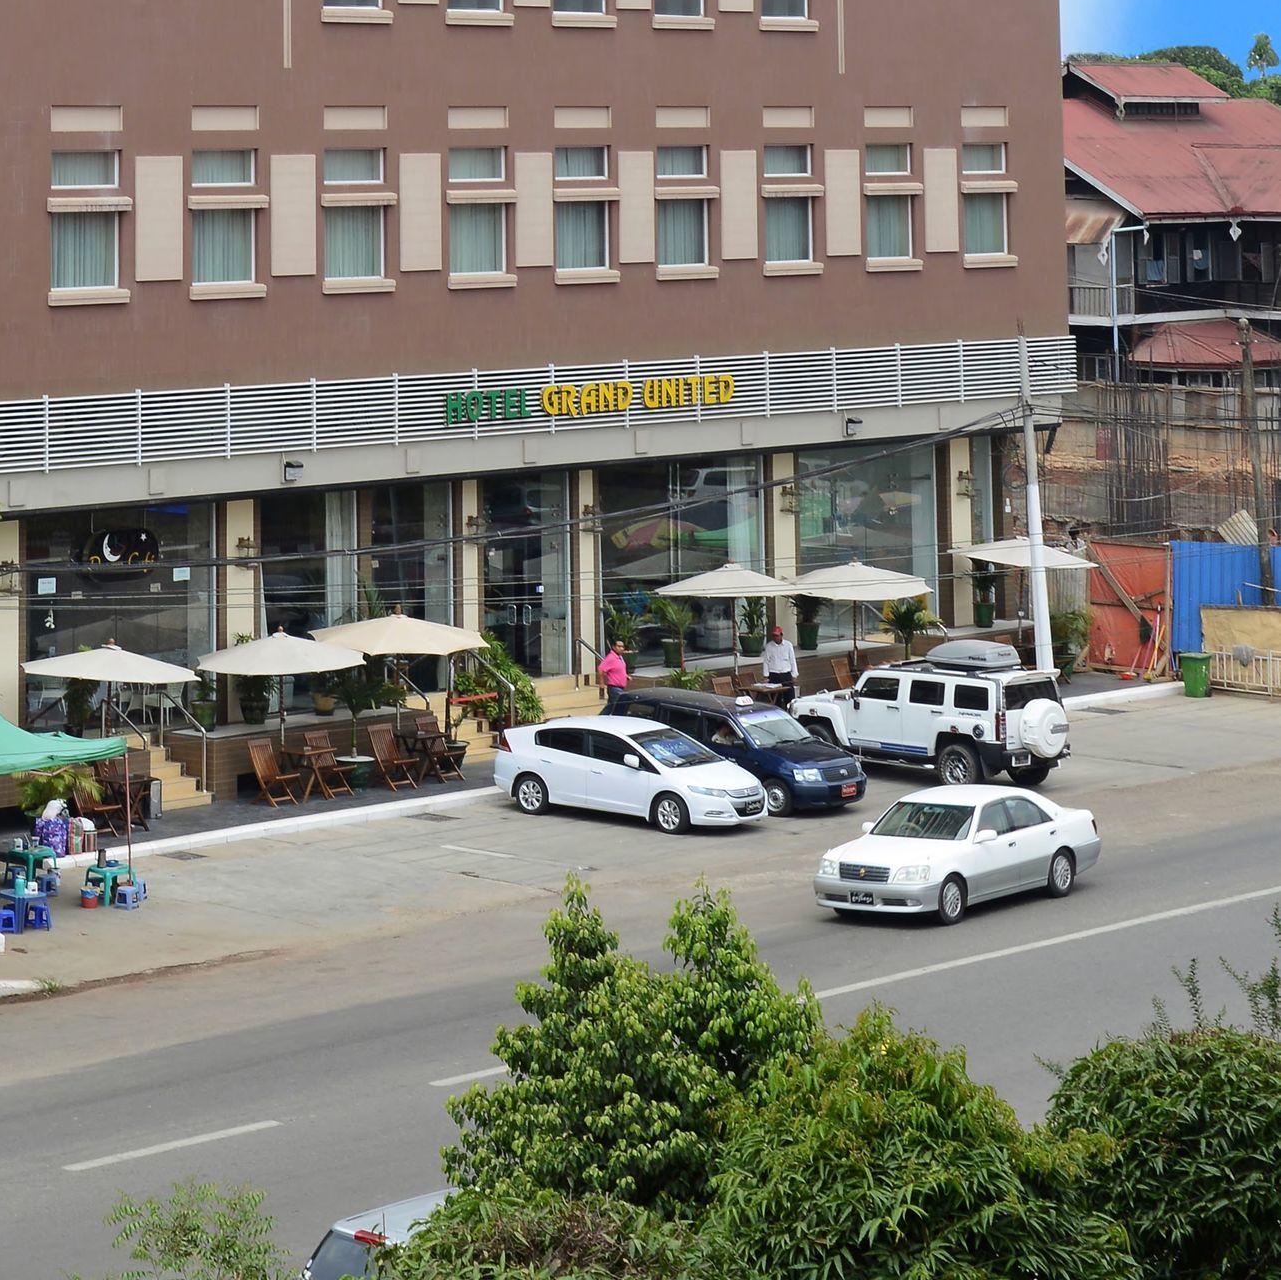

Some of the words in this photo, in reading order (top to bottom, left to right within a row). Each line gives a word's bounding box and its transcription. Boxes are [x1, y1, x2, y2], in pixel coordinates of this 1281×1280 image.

[444, 389, 531, 426] HOTEL
[540, 380, 633, 418] GRAND
[641, 375, 735, 408] UNITED
